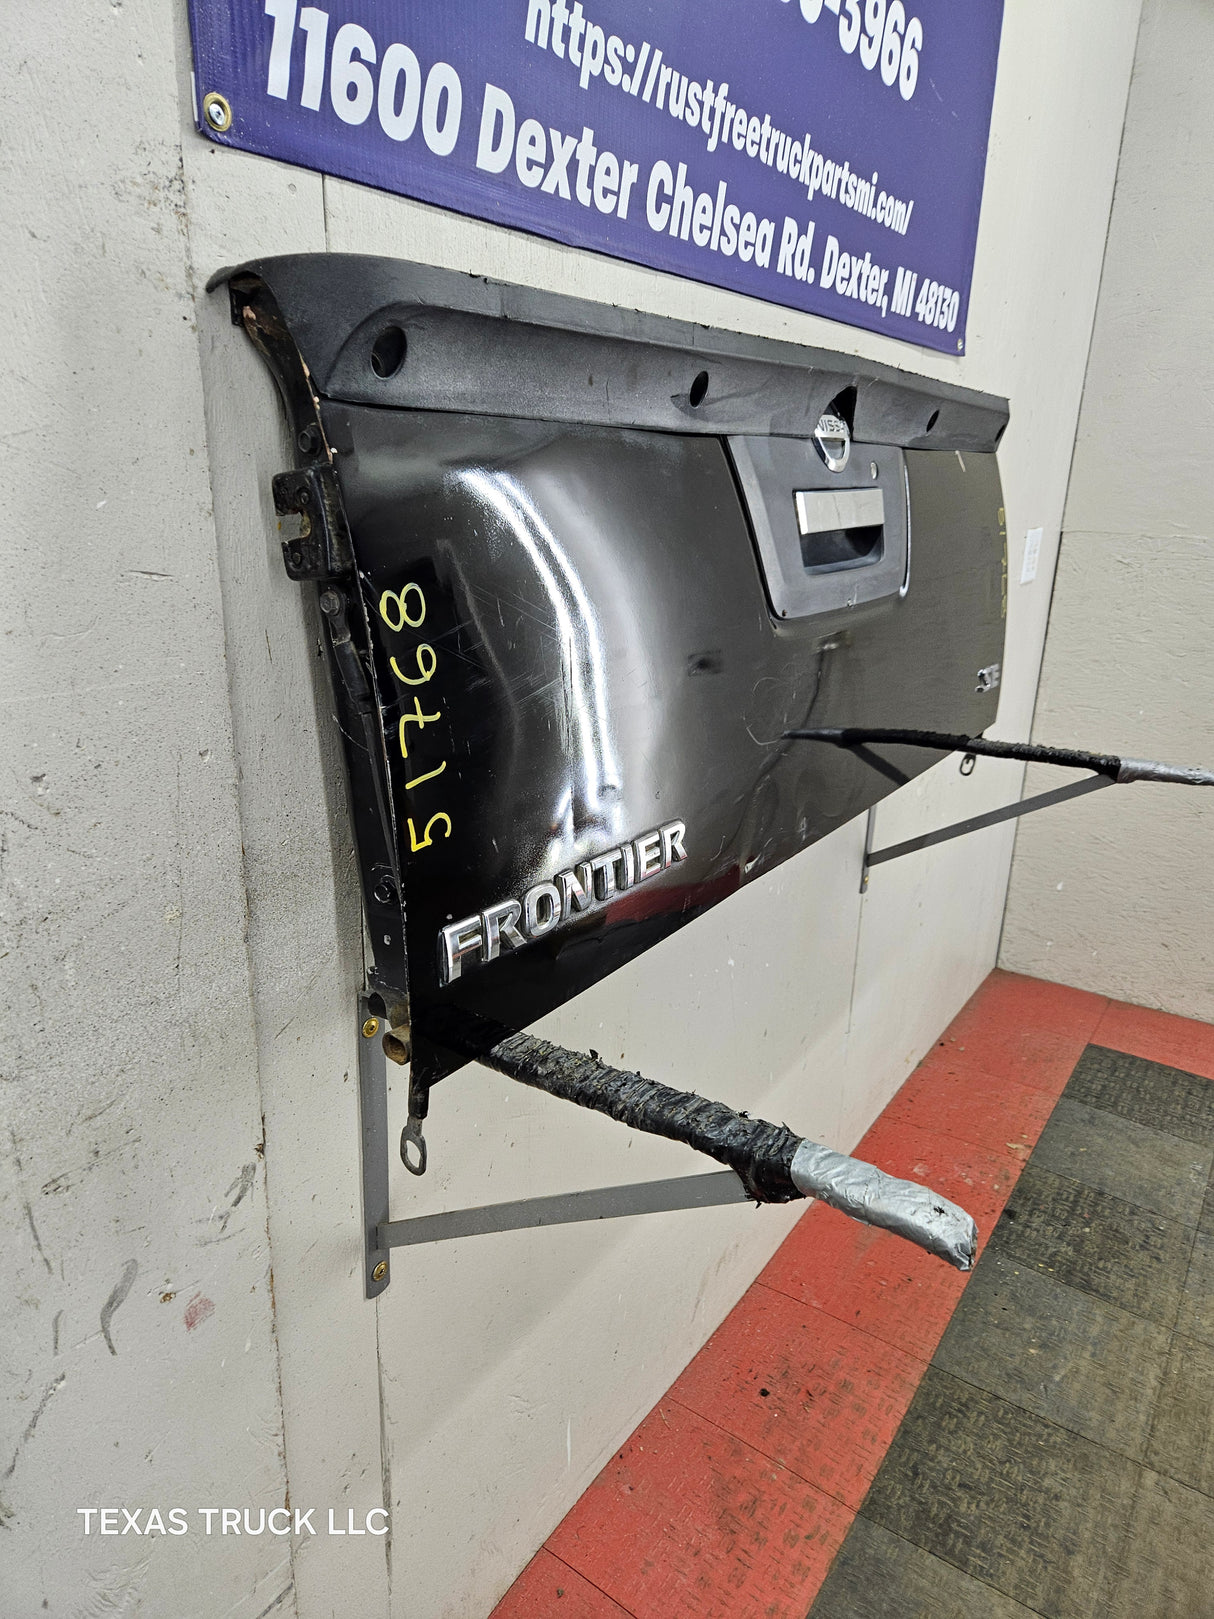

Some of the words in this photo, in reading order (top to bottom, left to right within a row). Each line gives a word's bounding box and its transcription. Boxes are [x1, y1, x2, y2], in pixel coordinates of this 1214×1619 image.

[264, 0, 462, 156] 11600
[476, 83, 639, 220] Dexter
[646, 160, 776, 269] Chelsea
[777, 216, 816, 284] Rd.
[820, 235, 889, 318] Dexter,
[890, 266, 919, 317] MI
[915, 278, 959, 332] 48130
[525, 0, 914, 235] https://rustfreetruckpartsmi.com/
[779, 0, 923, 100] -3966
[379, 582, 452, 852] 51768
[439, 818, 688, 987] FRONTIER
